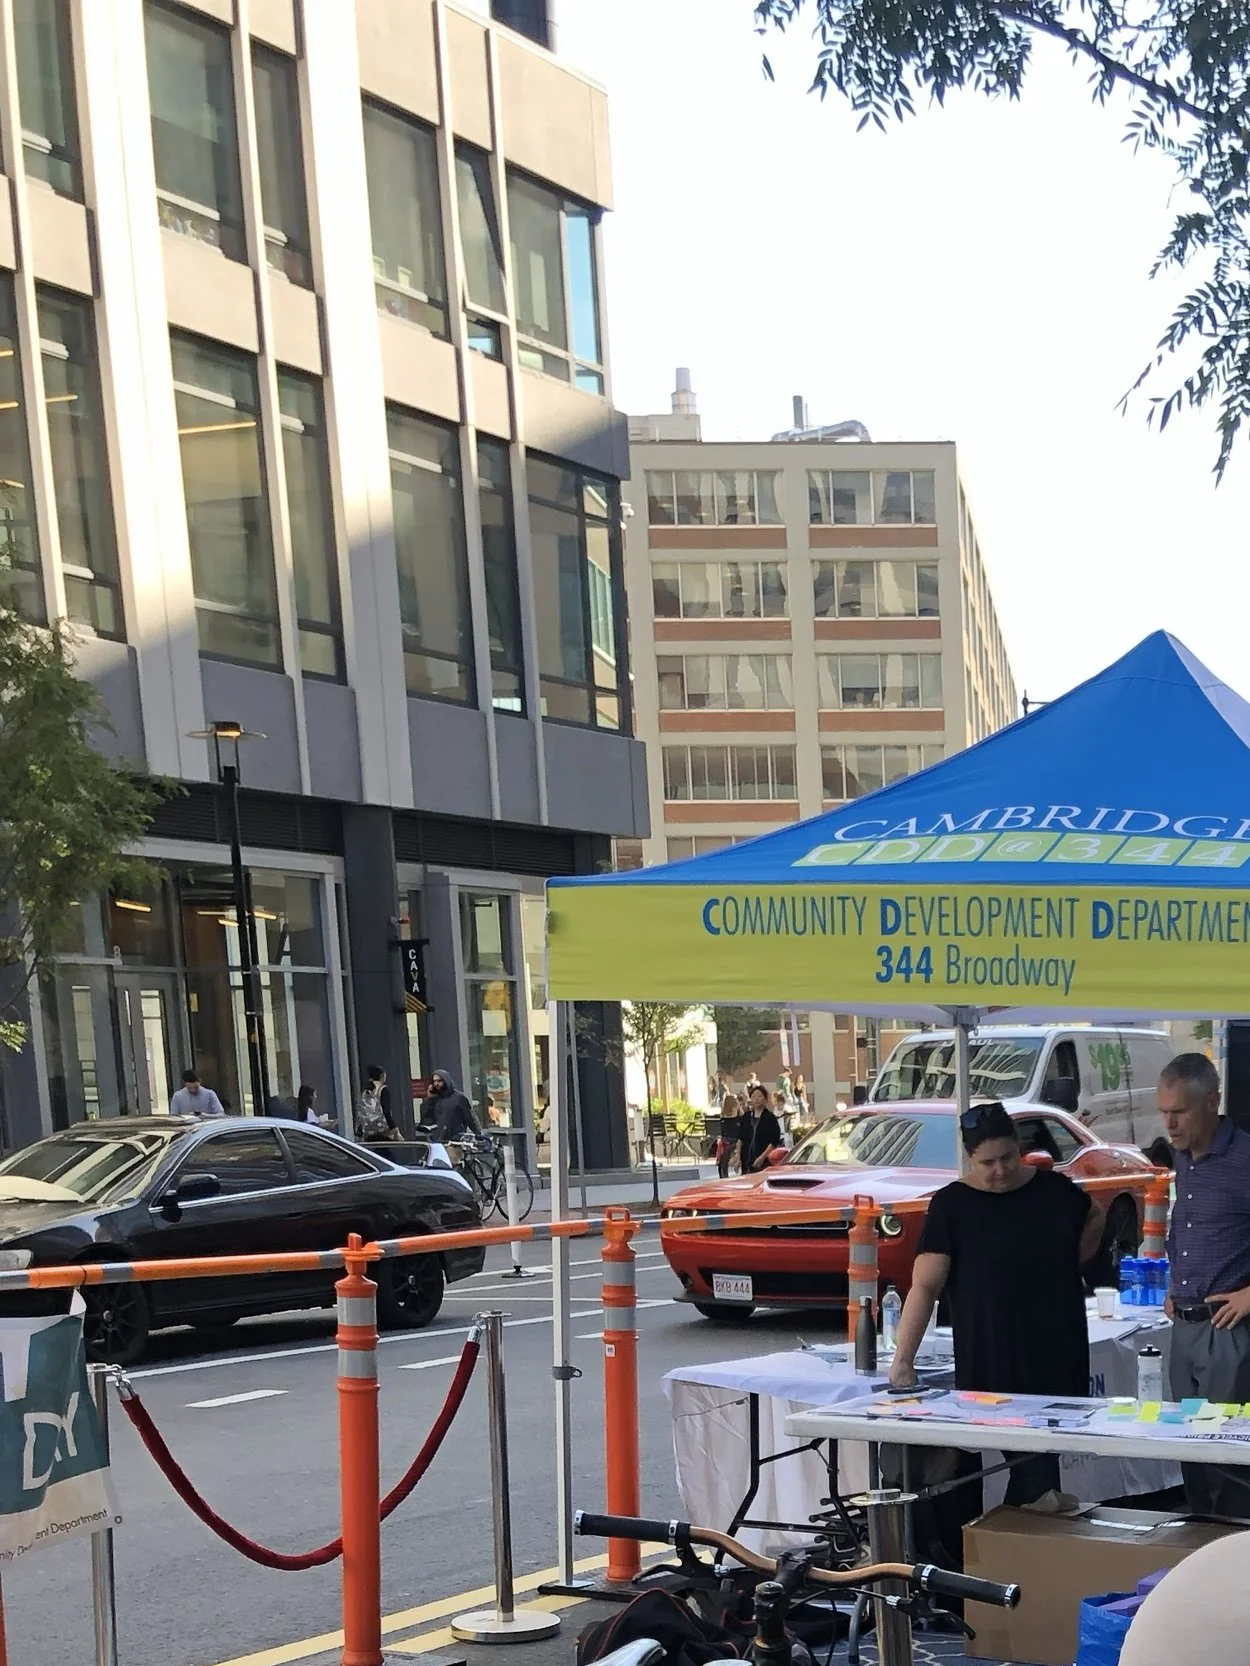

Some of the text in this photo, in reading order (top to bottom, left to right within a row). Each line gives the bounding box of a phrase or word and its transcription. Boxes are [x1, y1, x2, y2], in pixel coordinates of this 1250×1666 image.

[702, 896, 867, 936] COMMUNITY
[880, 896, 1080, 939] DEVELOPMENT
[408, 949, 420, 993] CAVA
[875, 943, 1076, 996] 344 Broadway
[23, 1391, 79, 1491] DY
[50, 1509, 107, 1533] Department
